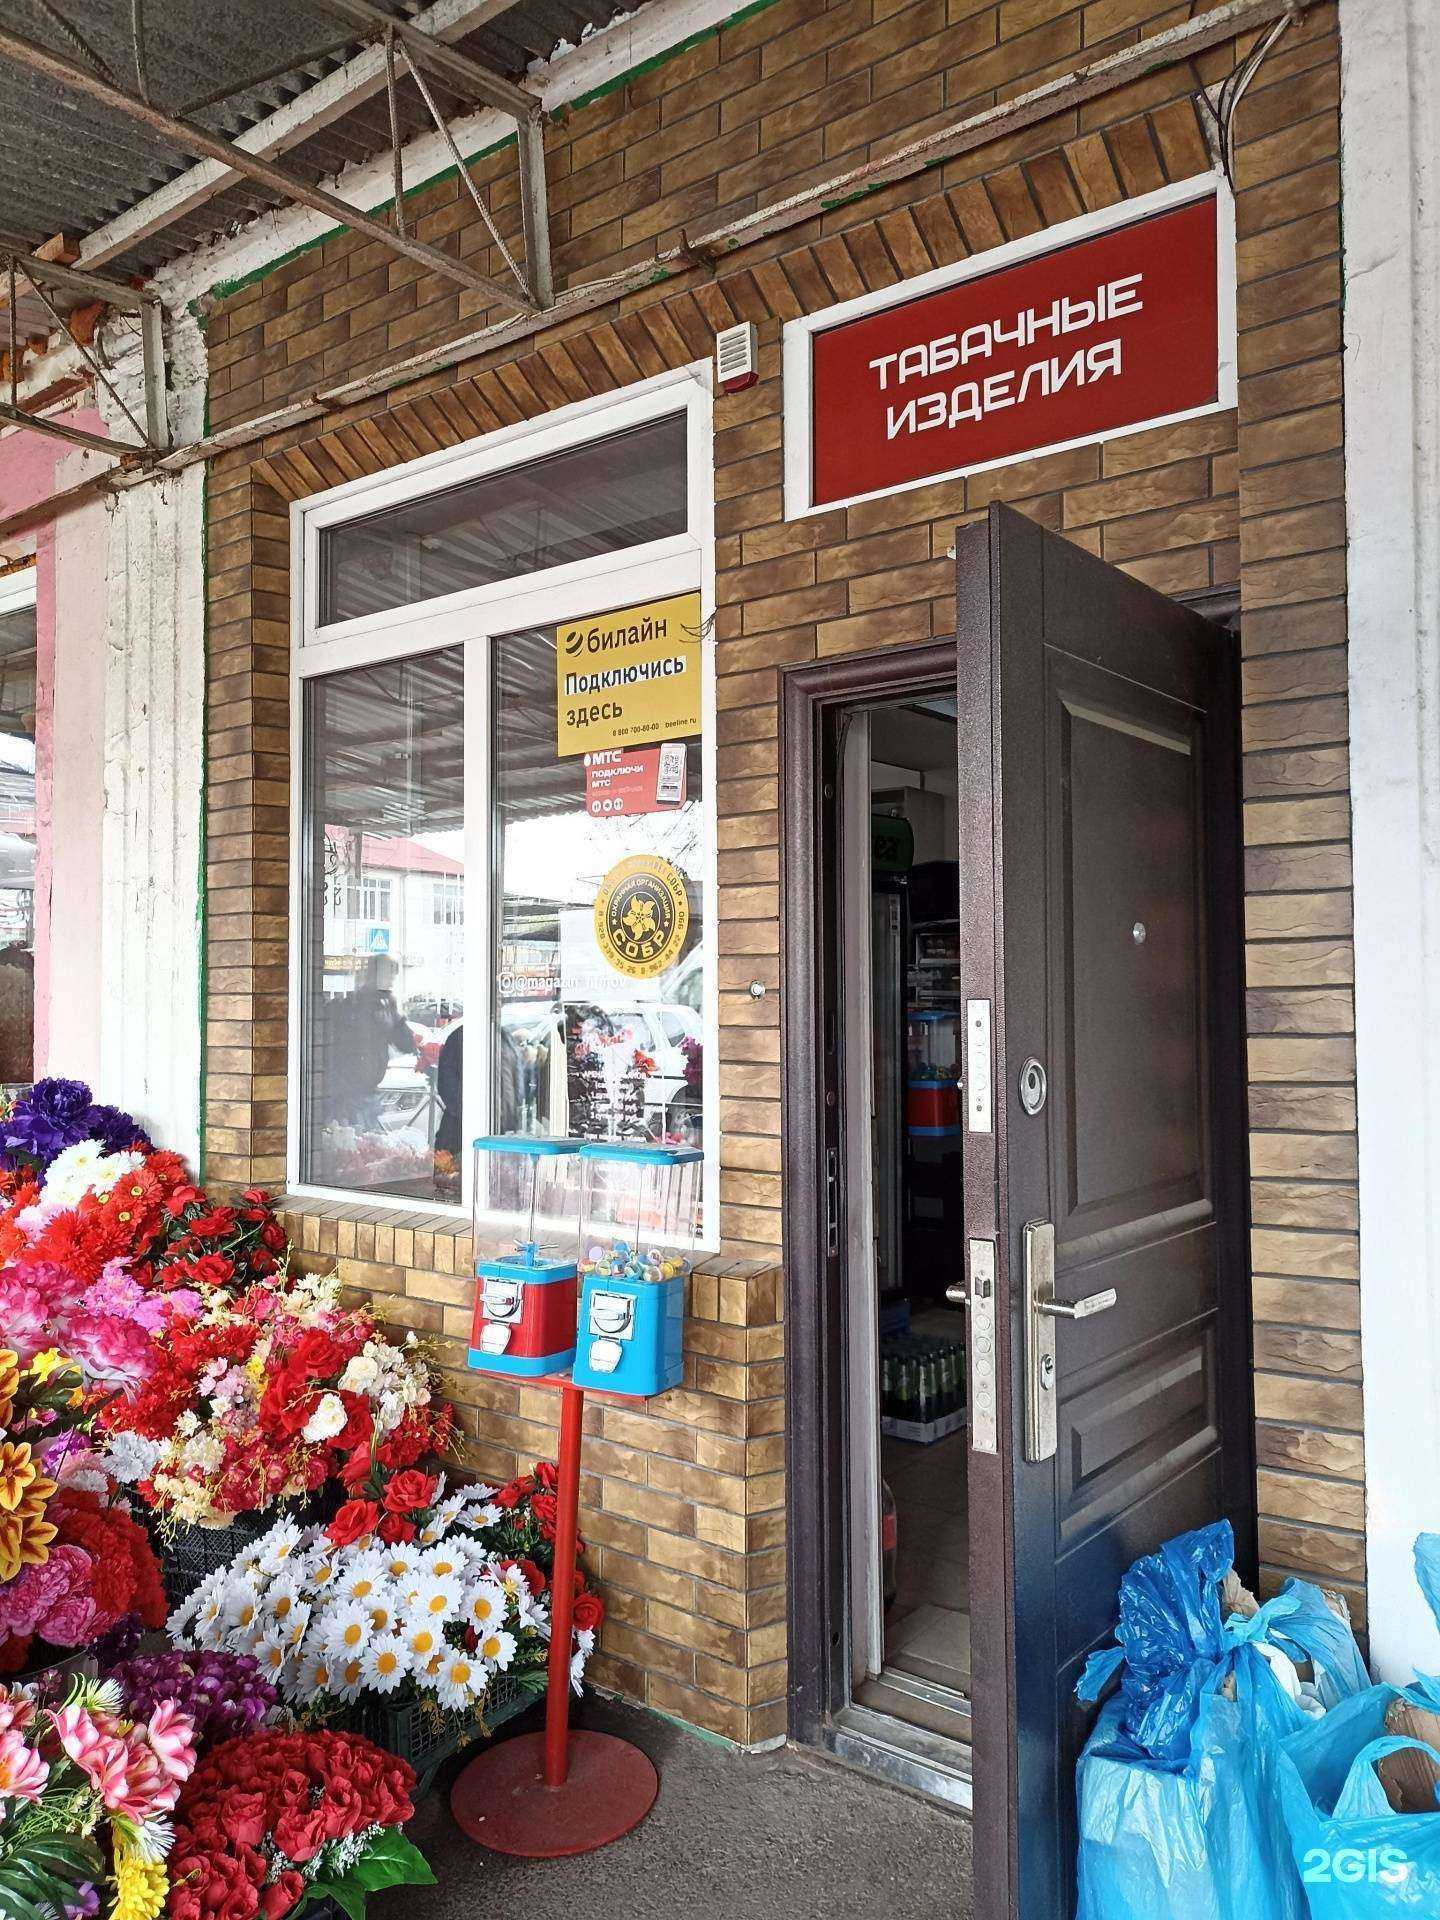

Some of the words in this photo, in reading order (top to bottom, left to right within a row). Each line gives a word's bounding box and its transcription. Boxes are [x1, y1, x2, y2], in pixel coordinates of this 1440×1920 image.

[869, 273, 1143, 390] ТАБАЧНЫЕ
[886, 338, 1122, 440] ИЗДЕЛИЯ
[587, 617, 667, 654] билайн
[565, 657, 685, 696] Подключись
[566, 702, 623, 728] здесь
[593, 749, 622, 766] МТС
[611, 879, 636, 917] ОХРАННАЯ
[636, 878, 671, 919] ОРГАНИЗАЦИЯ
[667, 872, 683, 897] СОБР
[612, 928, 665, 958] СОБР
